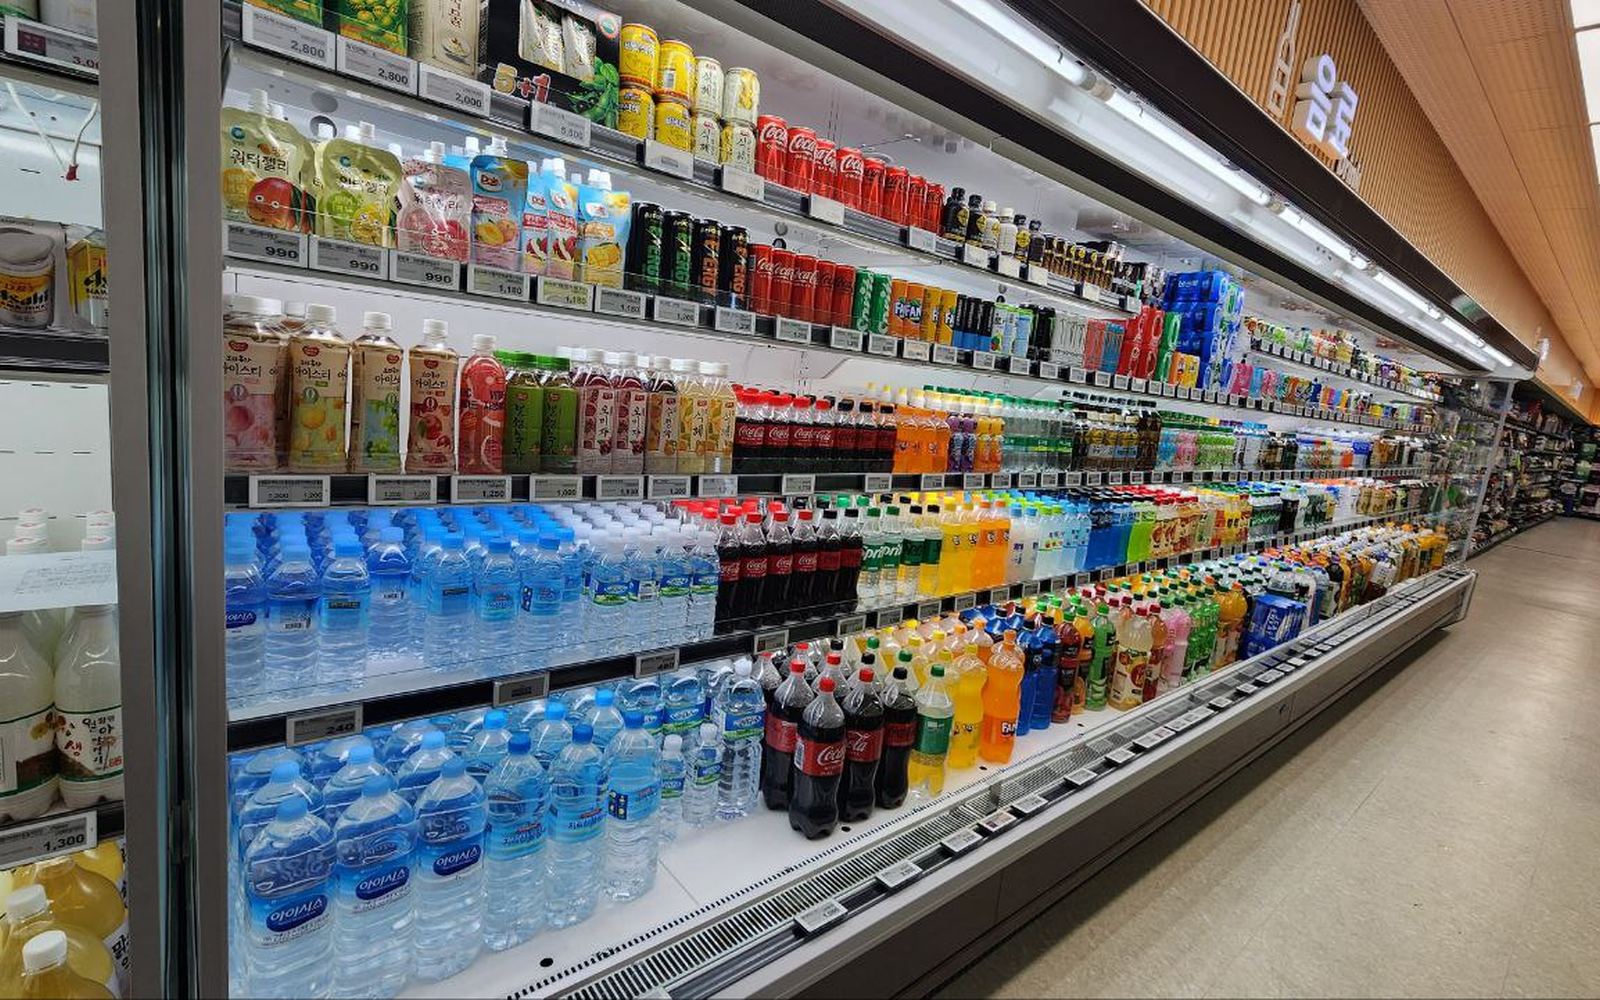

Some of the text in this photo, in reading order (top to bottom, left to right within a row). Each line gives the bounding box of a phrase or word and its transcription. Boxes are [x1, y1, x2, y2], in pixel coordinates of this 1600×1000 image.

[290, 39, 326, 59] 2,800
[377, 67, 410, 86] 2,800
[455, 92, 483, 109] 2,000
[230, 149, 289, 174] 워터젤리
[265, 246, 299, 259] 990
[350, 260, 379, 272] 990
[425, 272, 453, 285] 990
[43, 834, 86, 852] 1,300
